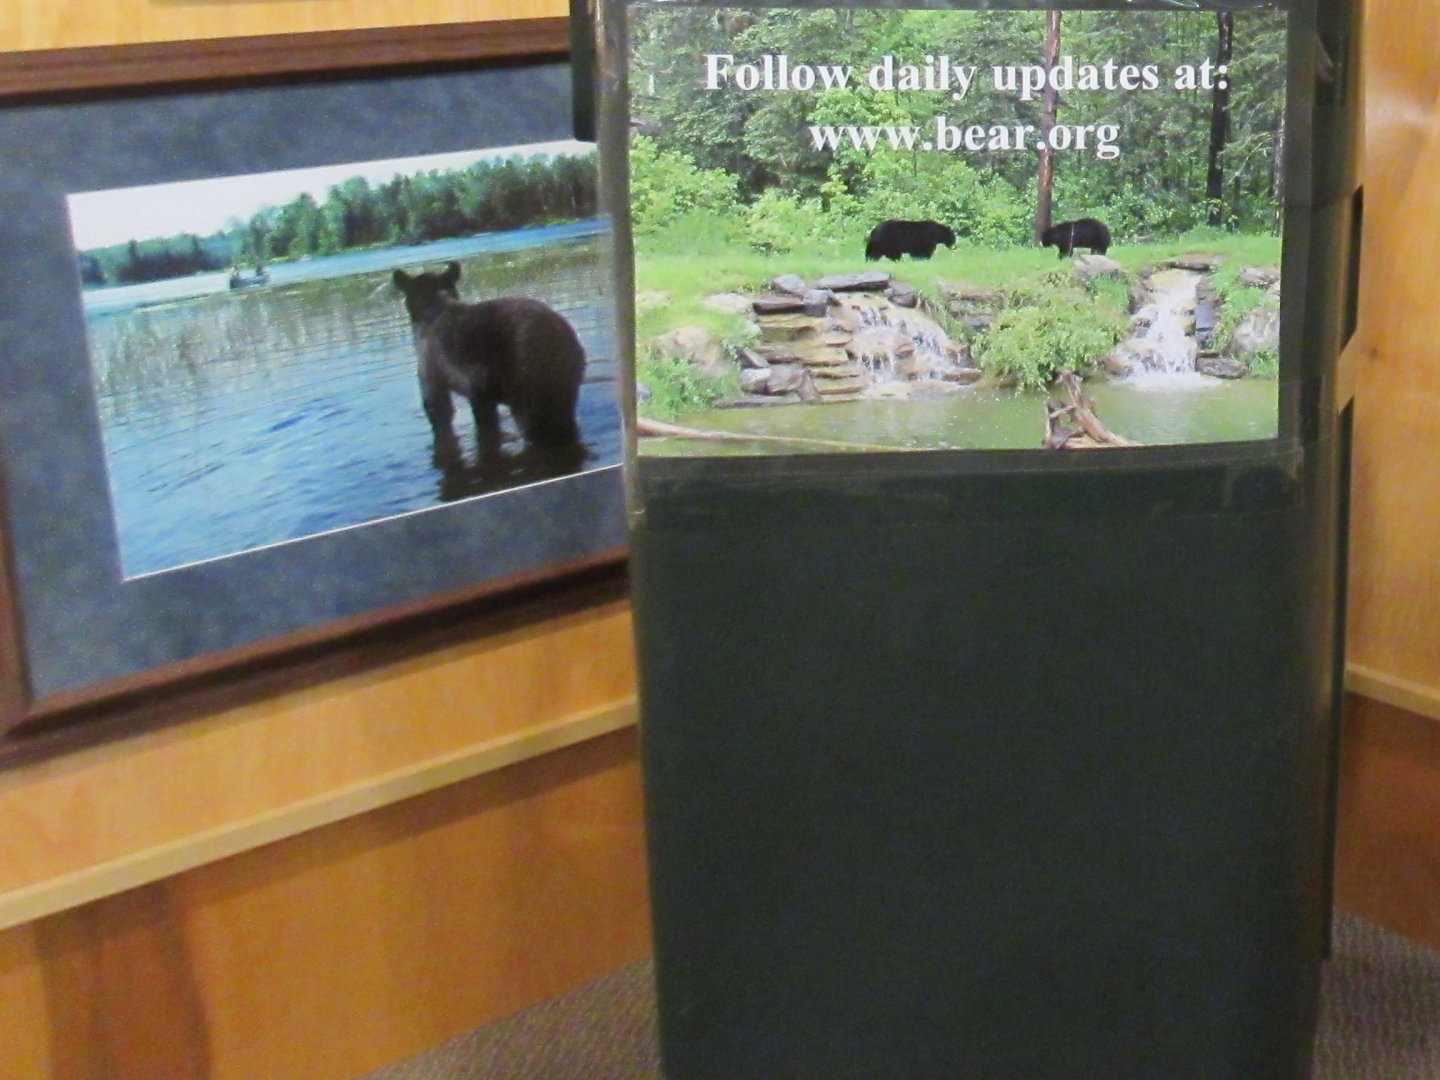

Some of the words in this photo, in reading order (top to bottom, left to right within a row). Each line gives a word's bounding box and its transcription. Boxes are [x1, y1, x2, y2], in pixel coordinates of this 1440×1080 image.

[703, 54, 854, 92] Follow
[868, 55, 978, 101] daily
[992, 55, 1160, 101] updates
[1173, 59, 1230, 91] at:
[808, 116, 1122, 159] www.bear.org
